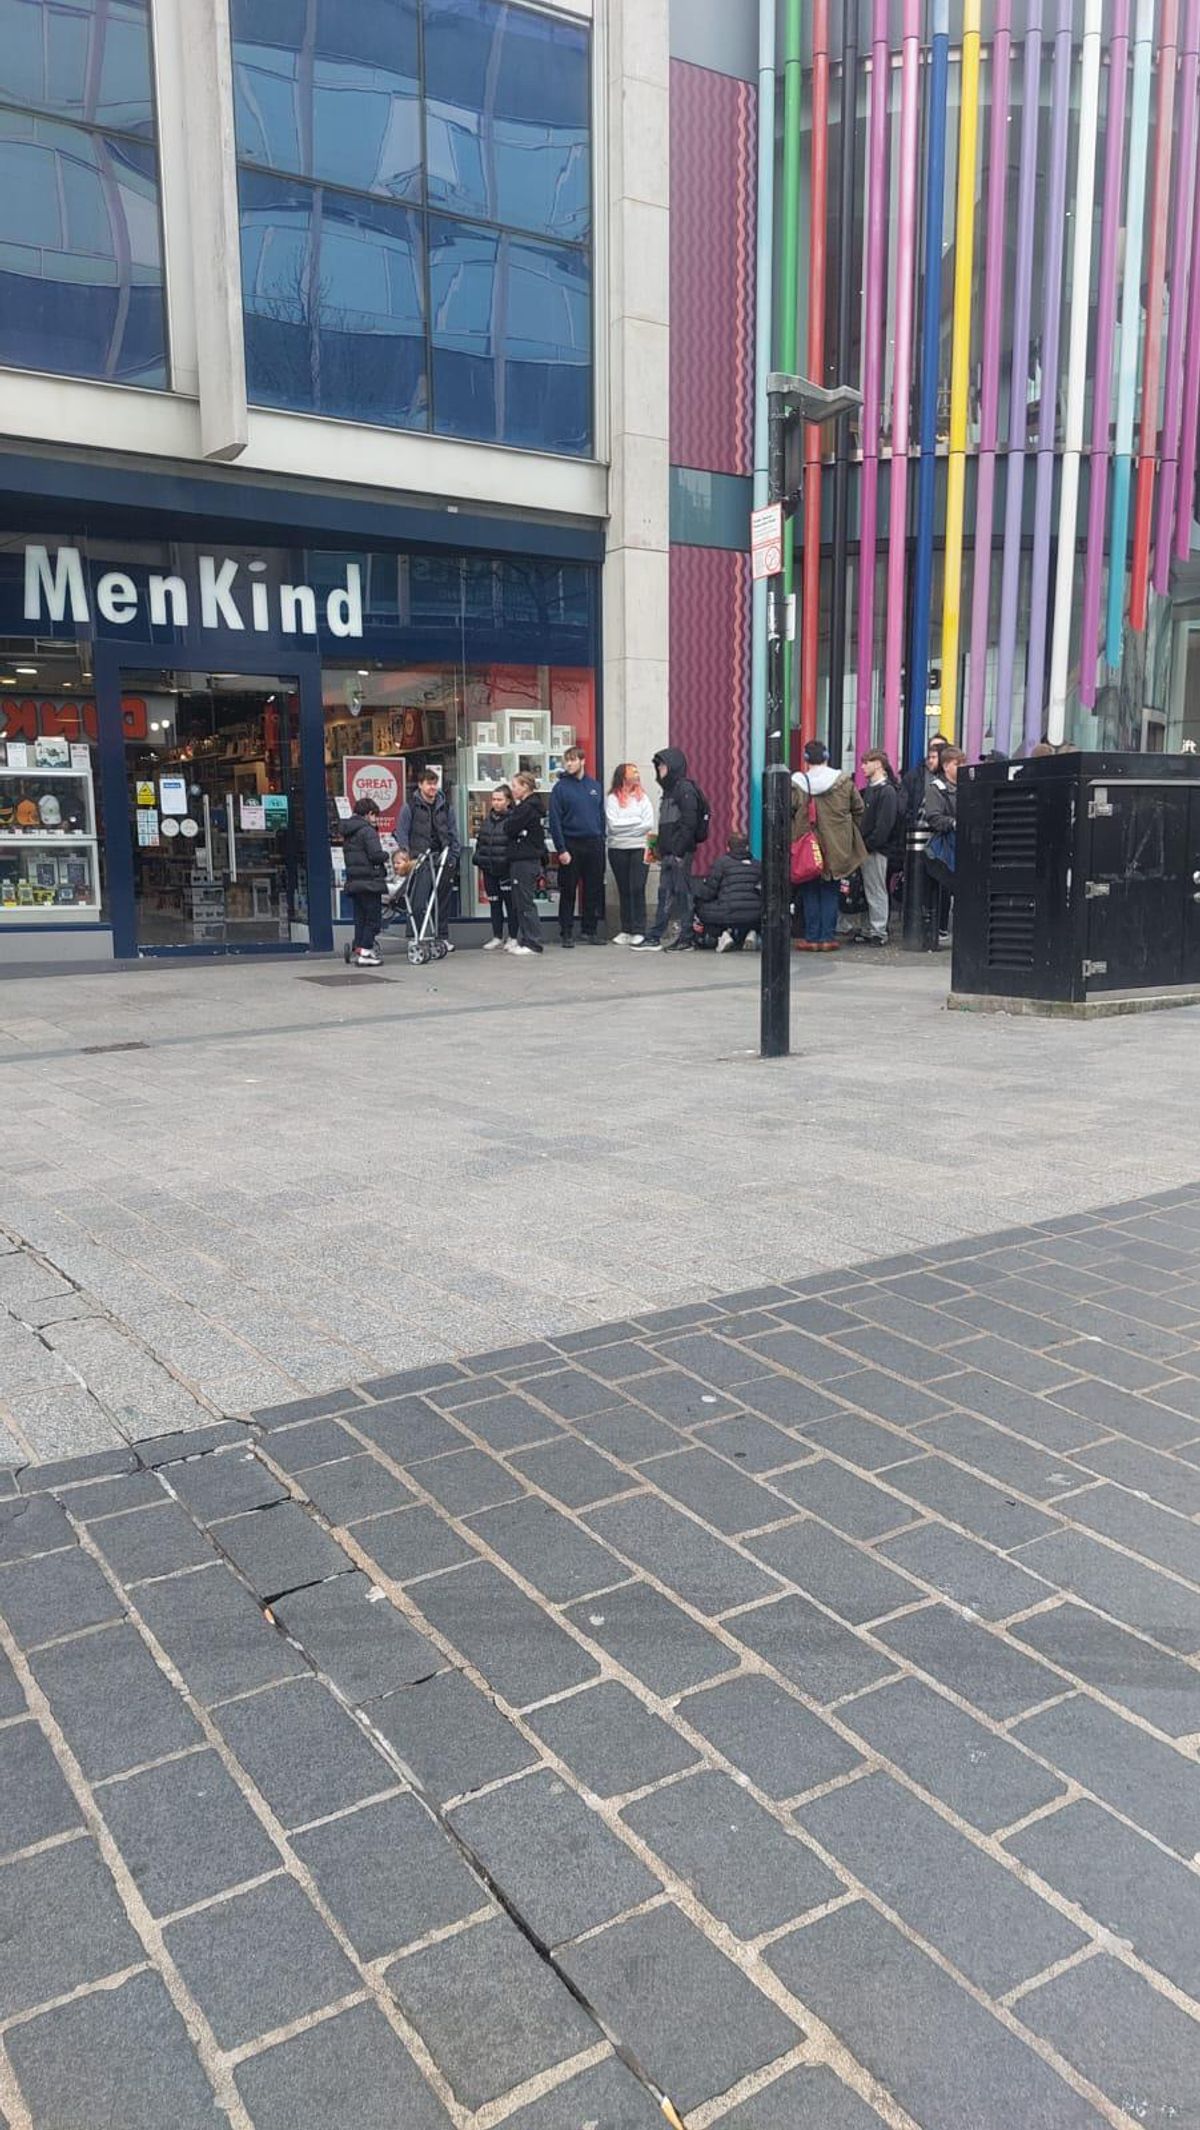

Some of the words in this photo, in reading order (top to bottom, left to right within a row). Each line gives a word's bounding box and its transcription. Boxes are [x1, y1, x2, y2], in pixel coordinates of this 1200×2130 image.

[24, 545, 363, 638] MenKind
[356, 778, 394, 789] GREAT
[360, 789, 392, 800] DEALS
